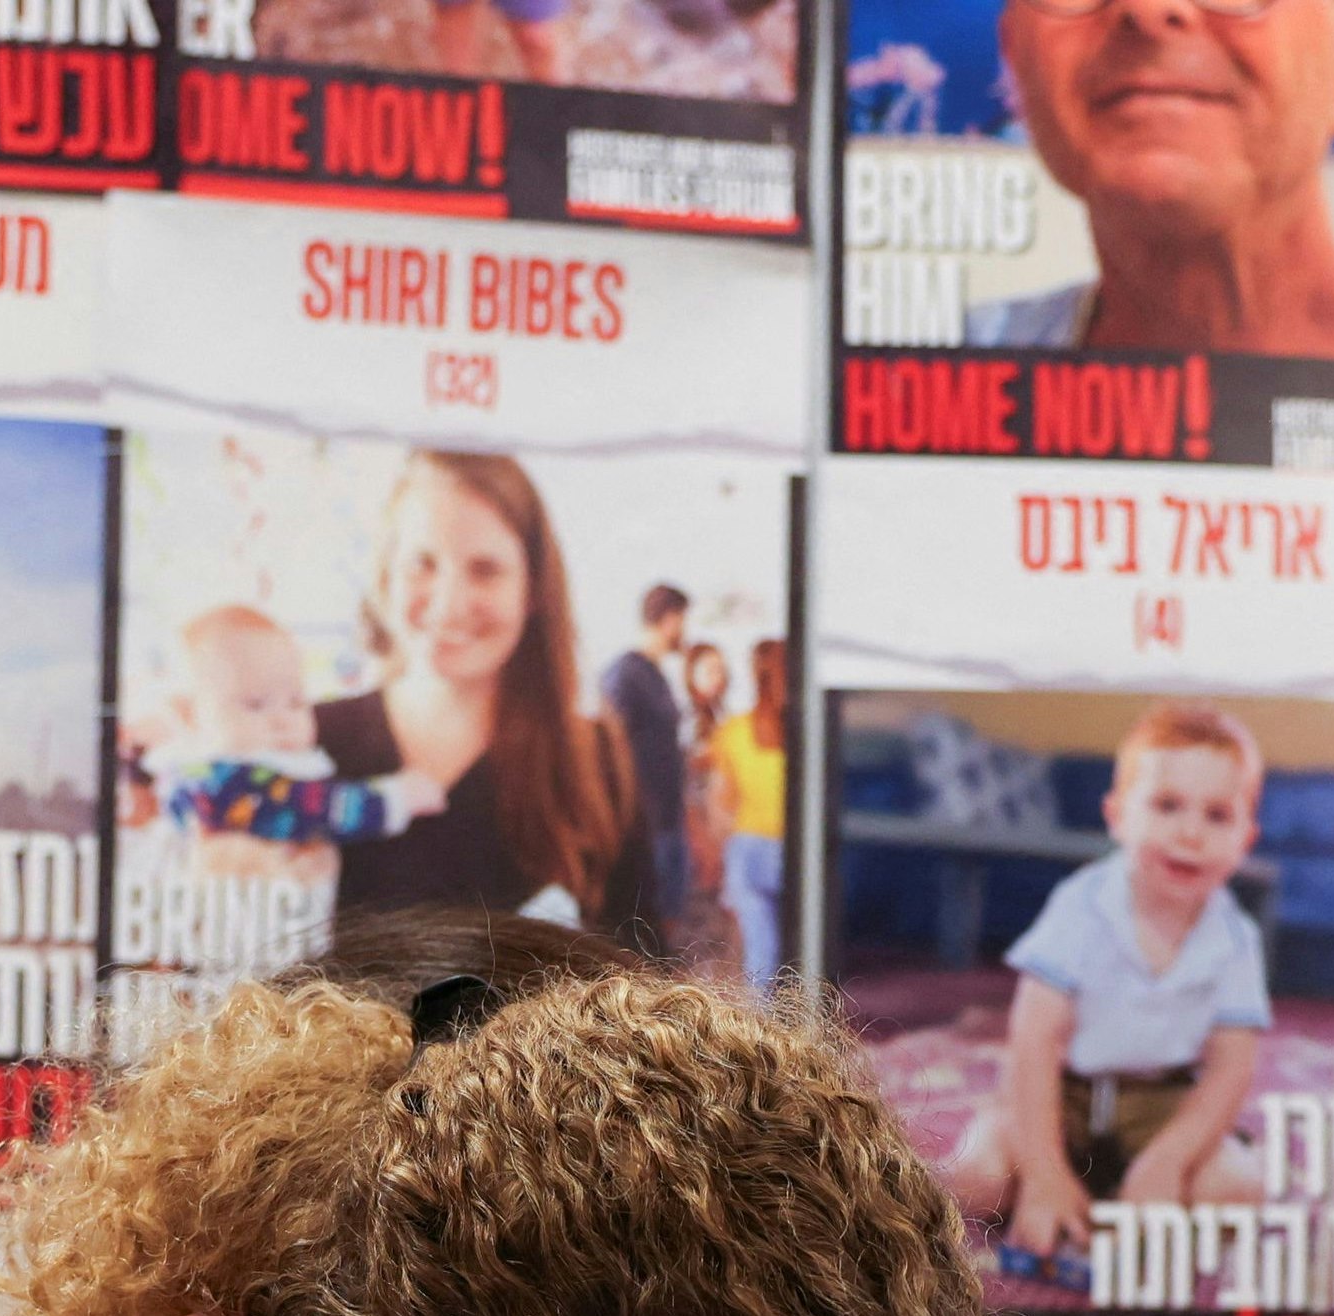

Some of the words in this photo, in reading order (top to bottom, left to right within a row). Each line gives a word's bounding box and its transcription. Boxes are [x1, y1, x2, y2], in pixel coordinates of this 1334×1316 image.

[177, 0, 259, 60] ER
[178, 67, 310, 170] OME
[323, 82, 506, 188] NOW!
[843, 152, 1035, 250] BRING
[300, 239, 449, 330] SHIRI
[469, 254, 627, 344] BIBES
[843, 250, 965, 348] HIM
[424, 350, 499, 410] (32)
[843, 356, 1021, 454] HOME
[1033, 354, 1211, 460] NOW!
[1017, 493, 1141, 574] ביבס
[1162, 494, 1326, 582] אריאל
[1088, 1203, 1310, 1311] הביתה
